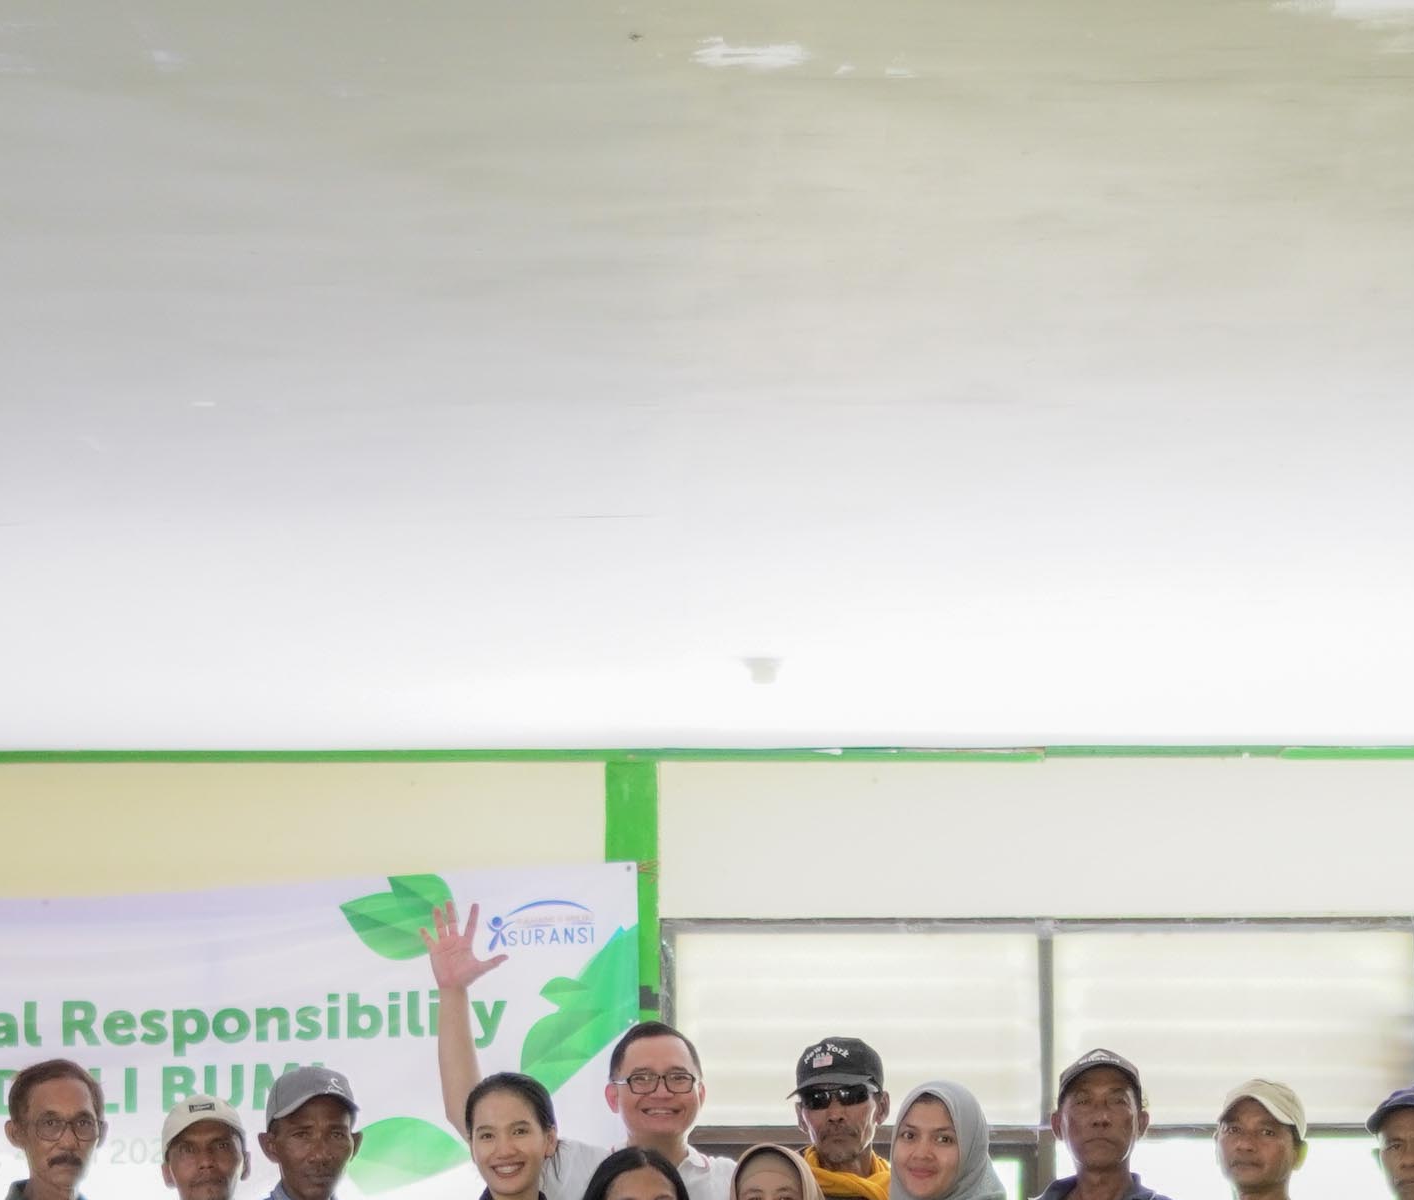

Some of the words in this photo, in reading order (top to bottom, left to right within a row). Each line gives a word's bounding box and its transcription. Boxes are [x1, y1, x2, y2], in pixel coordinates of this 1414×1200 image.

[62, 992, 507, 1056] Responsibiliy
[804, 1046, 822, 1065] New
[826, 1044, 849, 1059] York
[162, 1062, 326, 1114] BUM
